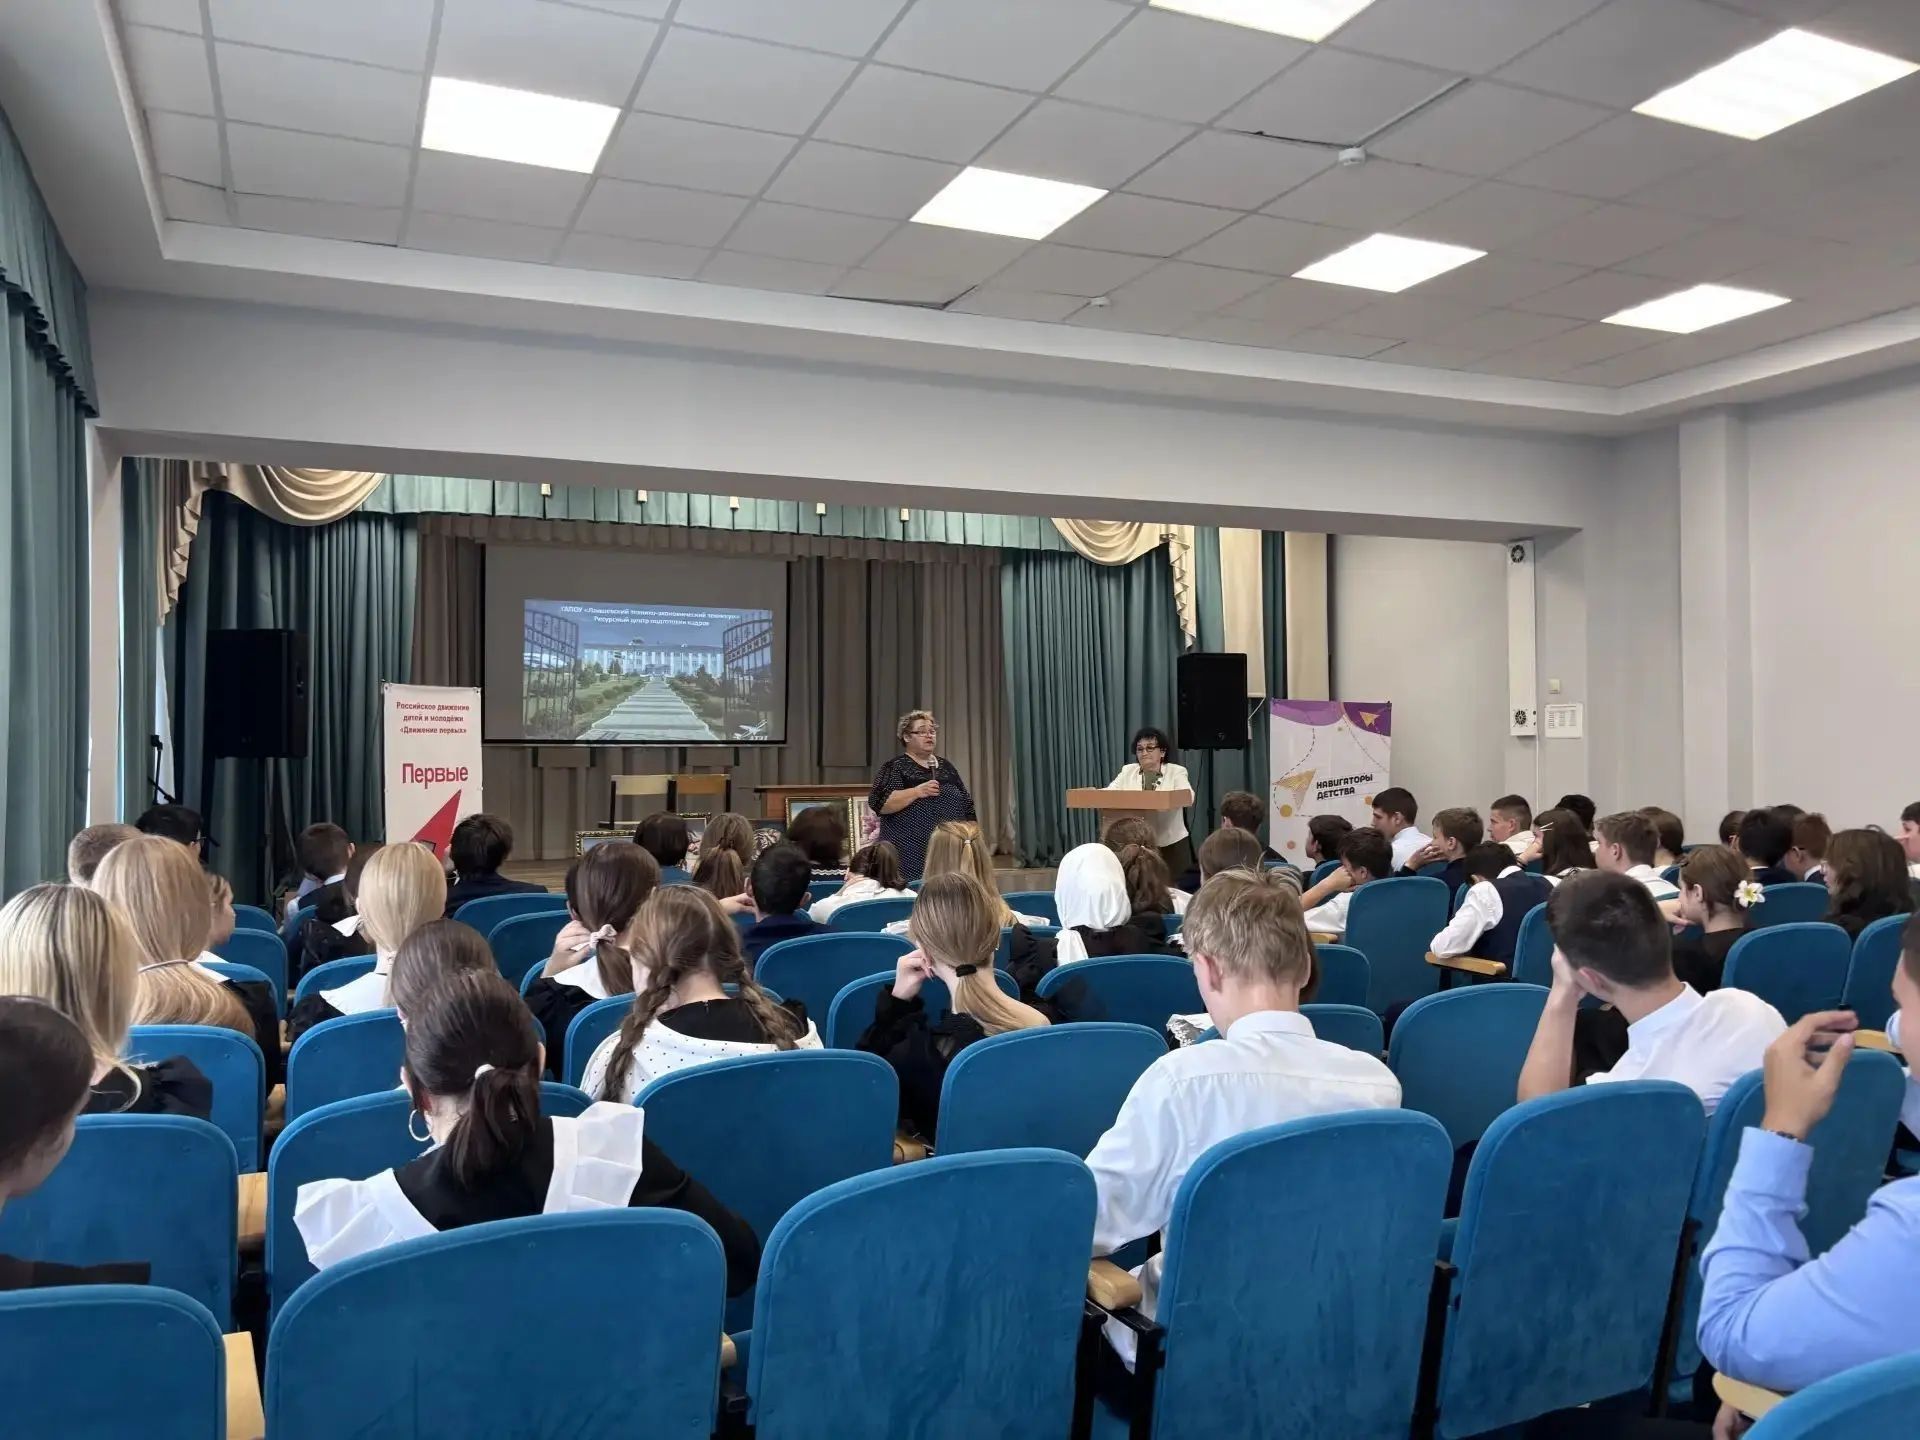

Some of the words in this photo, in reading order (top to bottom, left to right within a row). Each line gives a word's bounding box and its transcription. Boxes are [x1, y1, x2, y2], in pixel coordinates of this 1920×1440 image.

[396, 701, 436, 710] Российское
[403, 713, 423, 722] детей
[430, 715, 464, 723] молодёжи
[400, 726, 438, 735] «Движение
[402, 763, 468, 789] Первые
[1316, 774, 1373, 789] НАВИГАТОРЫ
[1317, 787, 1355, 800] ДЕТСТВА
